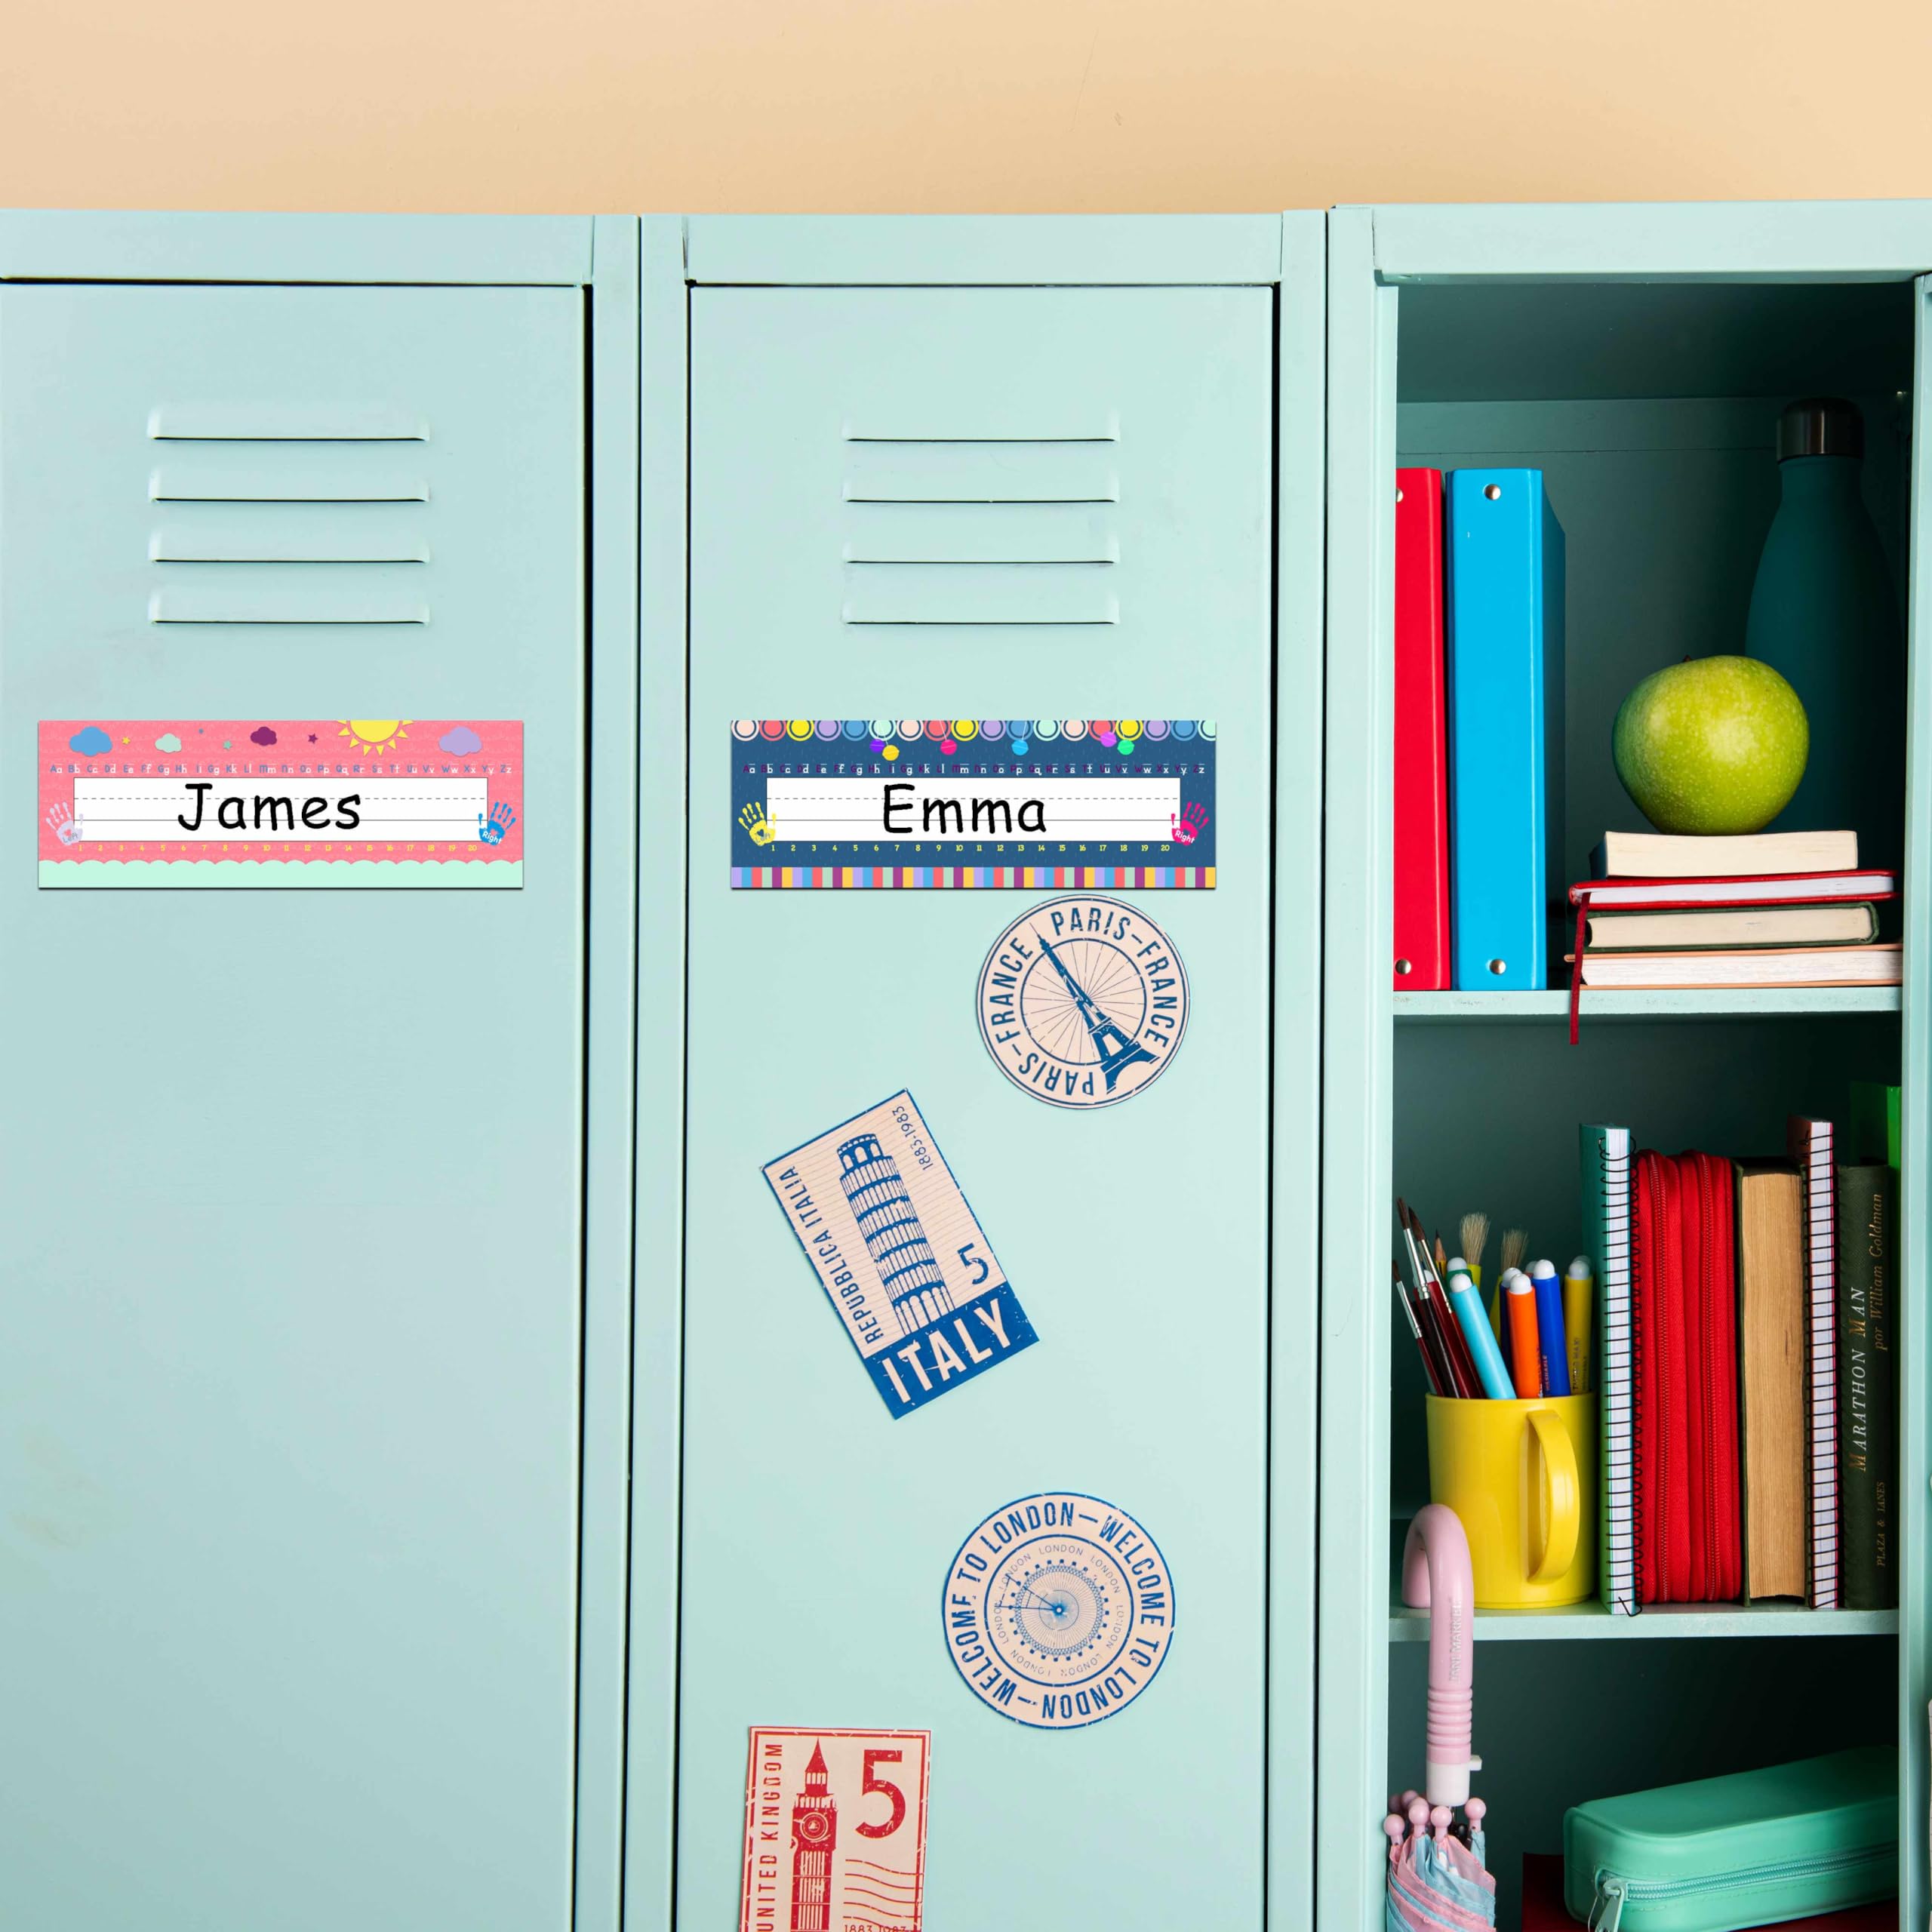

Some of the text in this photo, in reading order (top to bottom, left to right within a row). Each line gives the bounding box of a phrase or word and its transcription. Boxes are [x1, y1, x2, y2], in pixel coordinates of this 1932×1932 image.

[178, 783, 361, 832] James
[884, 783, 1047, 835] Emma
[482, 830, 502, 844] Right
[1174, 829, 1195, 844] Right
[892, 1106, 934, 1171] 1883-1983
[779, 1165, 884, 1345] REPUBBLICA ITALIA
[957, 1243, 989, 1285] 5
[1869, 1194, 1887, 1351] por William Goldman
[882, 1298, 1011, 1403] ITALY
[1848, 1286, 1866, 1472] MARATHON MAN
[1877, 1519, 1884, 1527] &
[956, 1552, 988, 1583] TO
[1038, 1544, 1084, 1557] LONDON
[1088, 1554, 1122, 1594] LONDON
[1877, 1534, 1885, 1567] PLAZA
[855, 1749, 906, 1839] 5
[756, 1744, 783, 1932] UNITED KINGDOM
